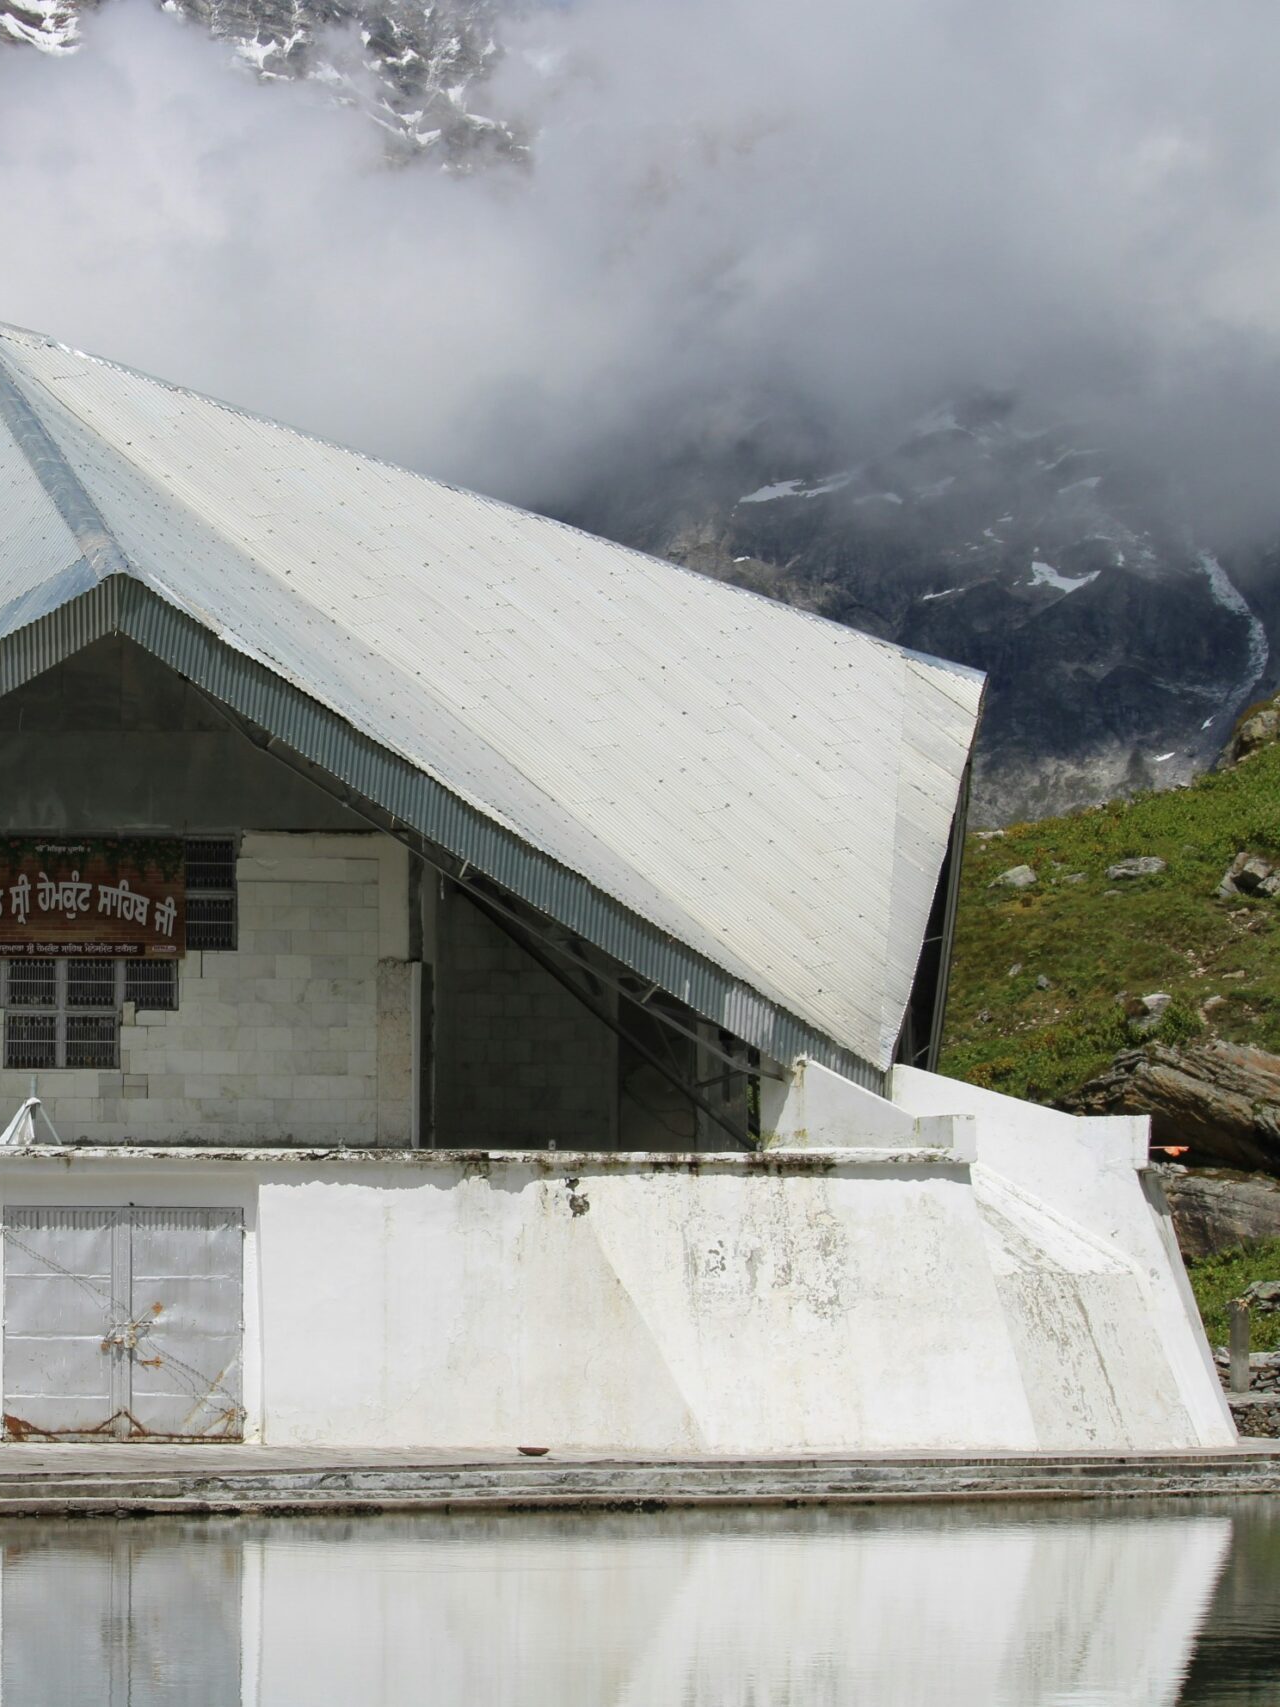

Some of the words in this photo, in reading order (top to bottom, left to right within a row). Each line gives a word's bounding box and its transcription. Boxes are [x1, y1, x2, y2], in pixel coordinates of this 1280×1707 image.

[9, 874, 31, 925] ਸ੍ਰੀ
[37, 870, 92, 919] ਹੇਮਕੁੰਟ
[98, 879, 150, 926] ਸਾਹਿਬ
[155, 896, 177, 937] ਜੀ
